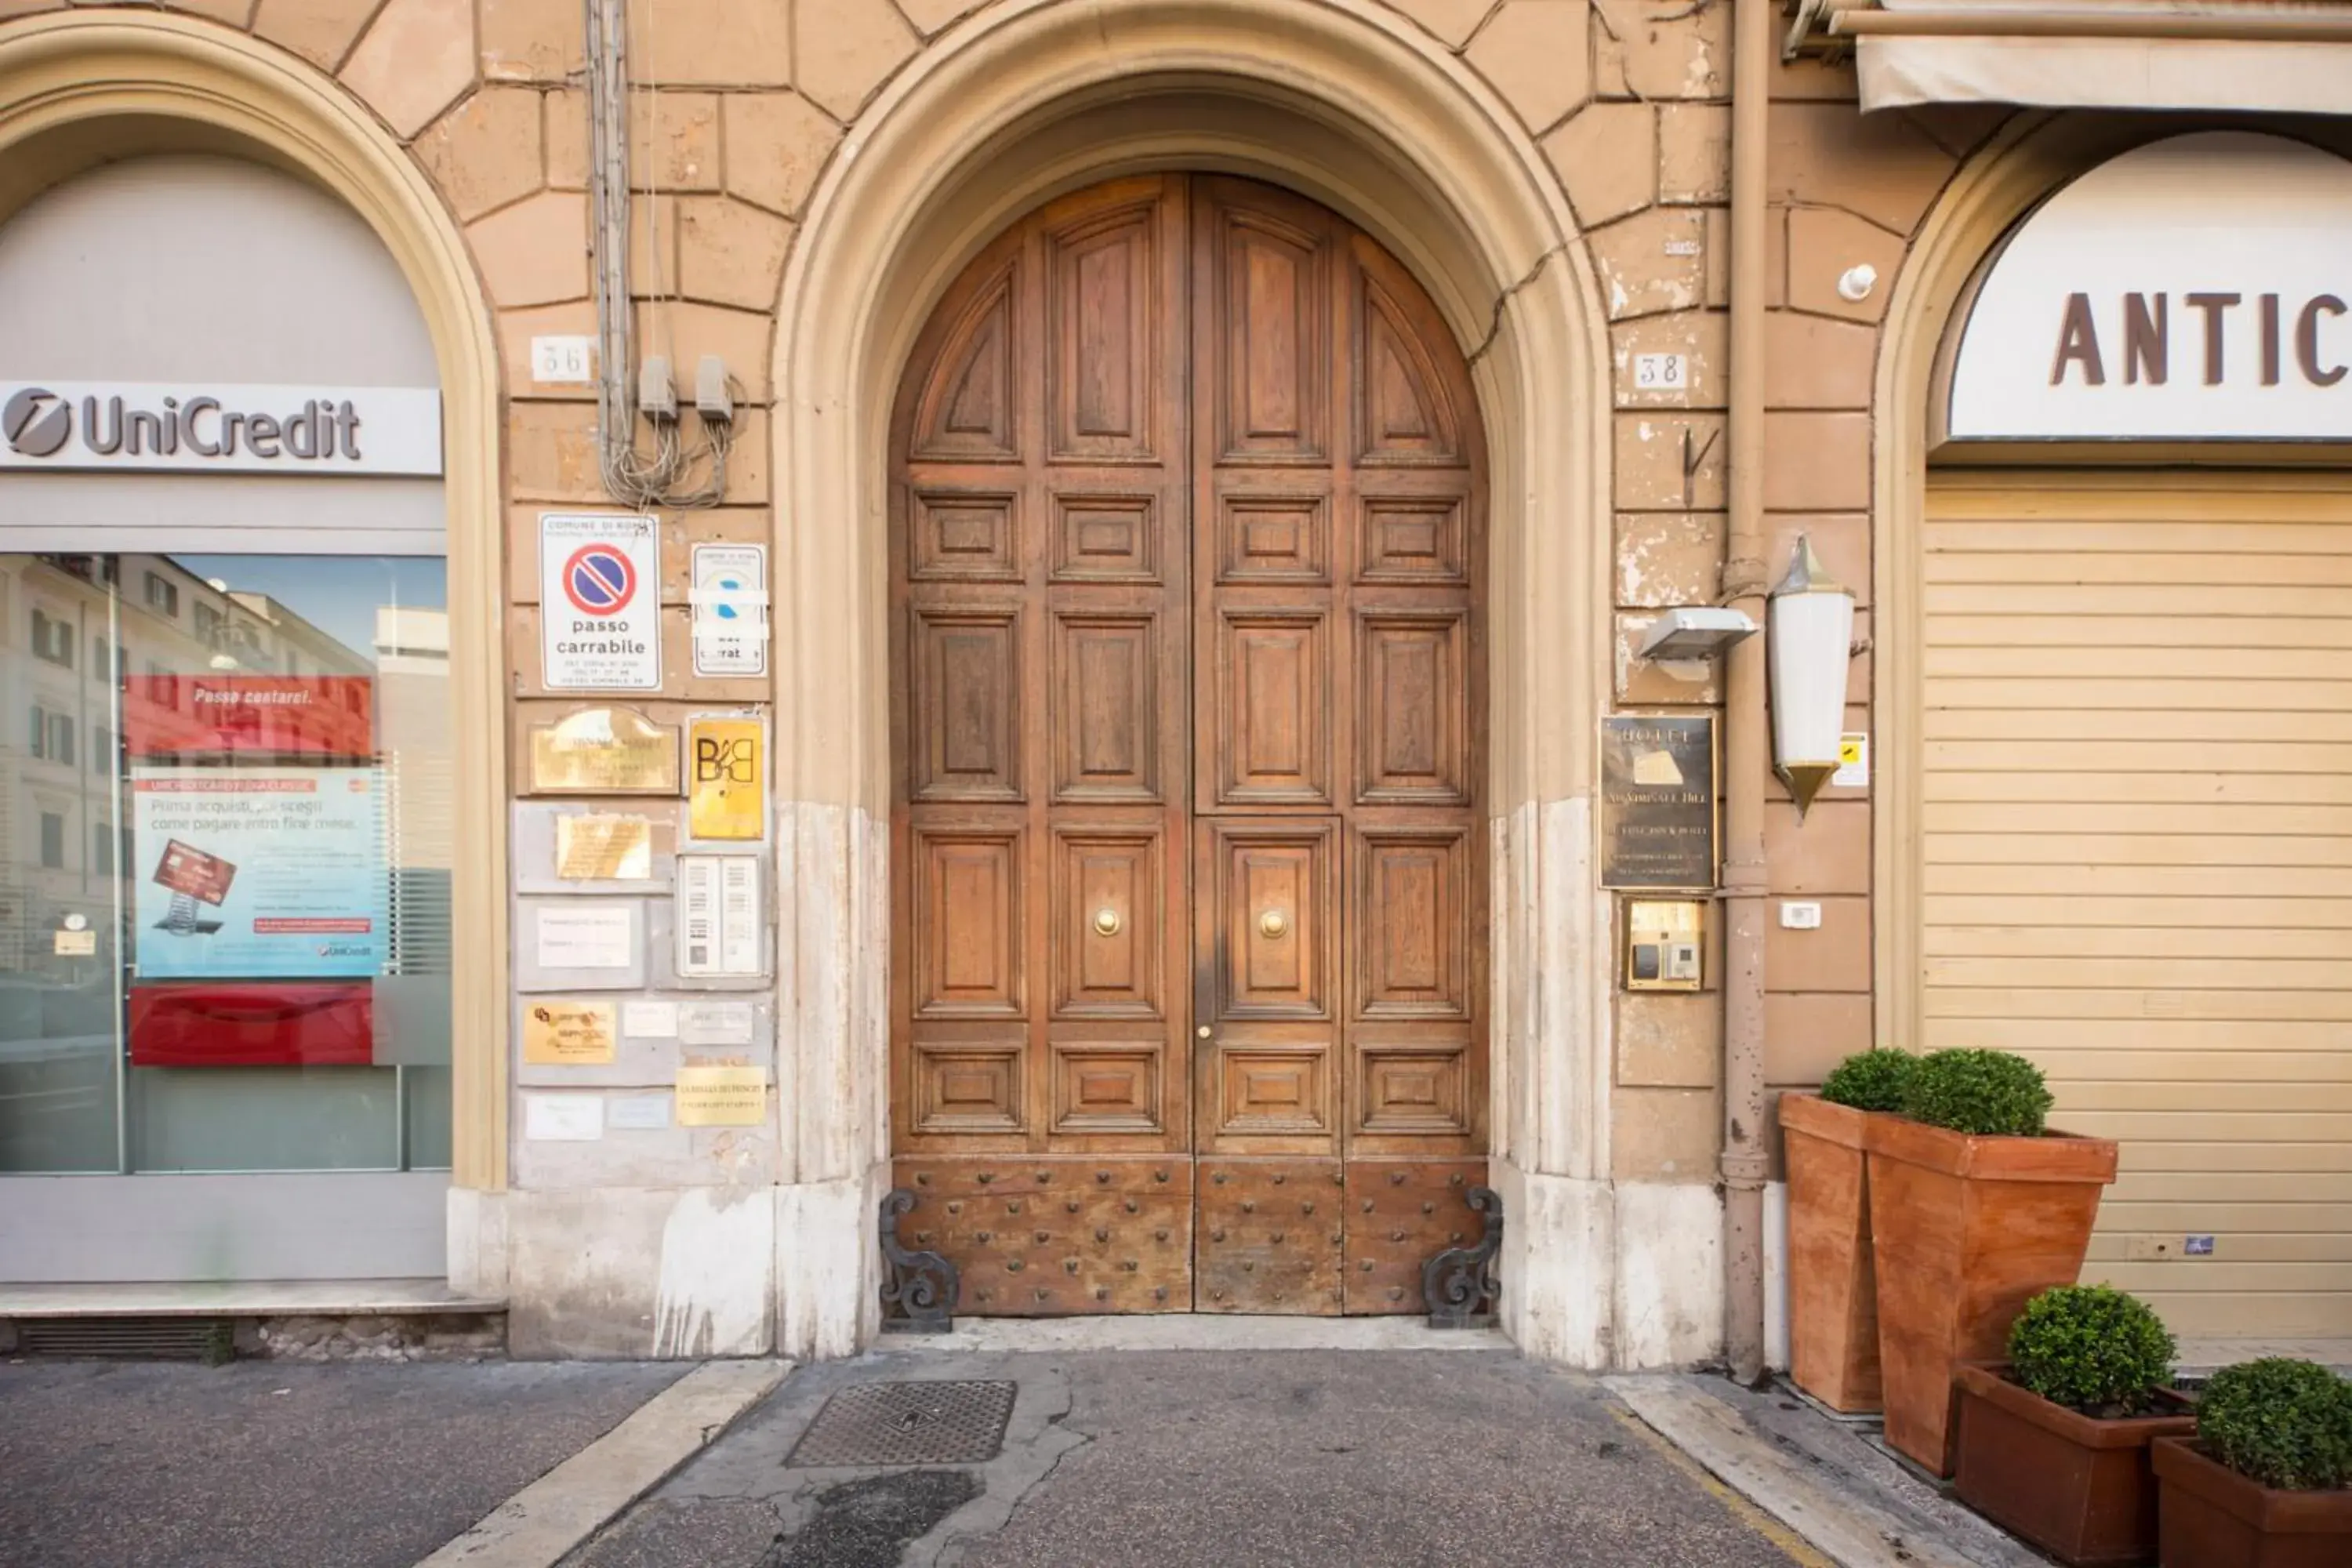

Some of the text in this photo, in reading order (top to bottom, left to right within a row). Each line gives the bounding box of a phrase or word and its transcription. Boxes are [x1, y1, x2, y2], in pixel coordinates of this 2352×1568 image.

[2048, 292, 2350, 387] ANTIC
[1639, 355, 1678, 383] 38
[82, 395, 361, 459] UniCredit
[572, 619, 630, 633] passo
[557, 639, 645, 655] carrabile
[194, 688, 239, 704] Posso
